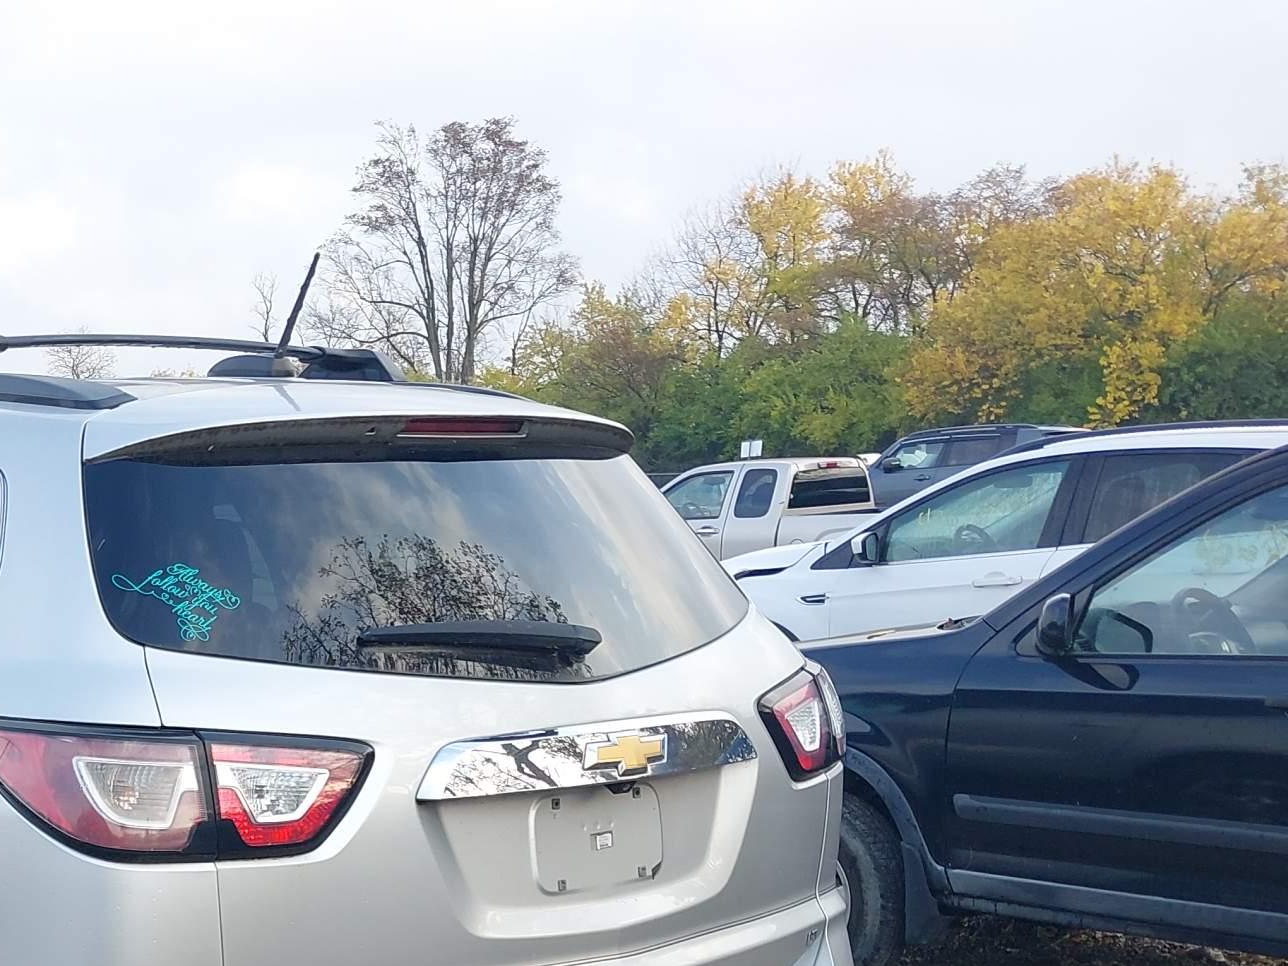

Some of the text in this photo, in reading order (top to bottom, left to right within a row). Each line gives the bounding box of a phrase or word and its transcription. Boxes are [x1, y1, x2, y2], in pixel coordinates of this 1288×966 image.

[126, 570, 190, 598] follow
[167, 564, 230, 604] Always
[172, 601, 218, 632] heart
